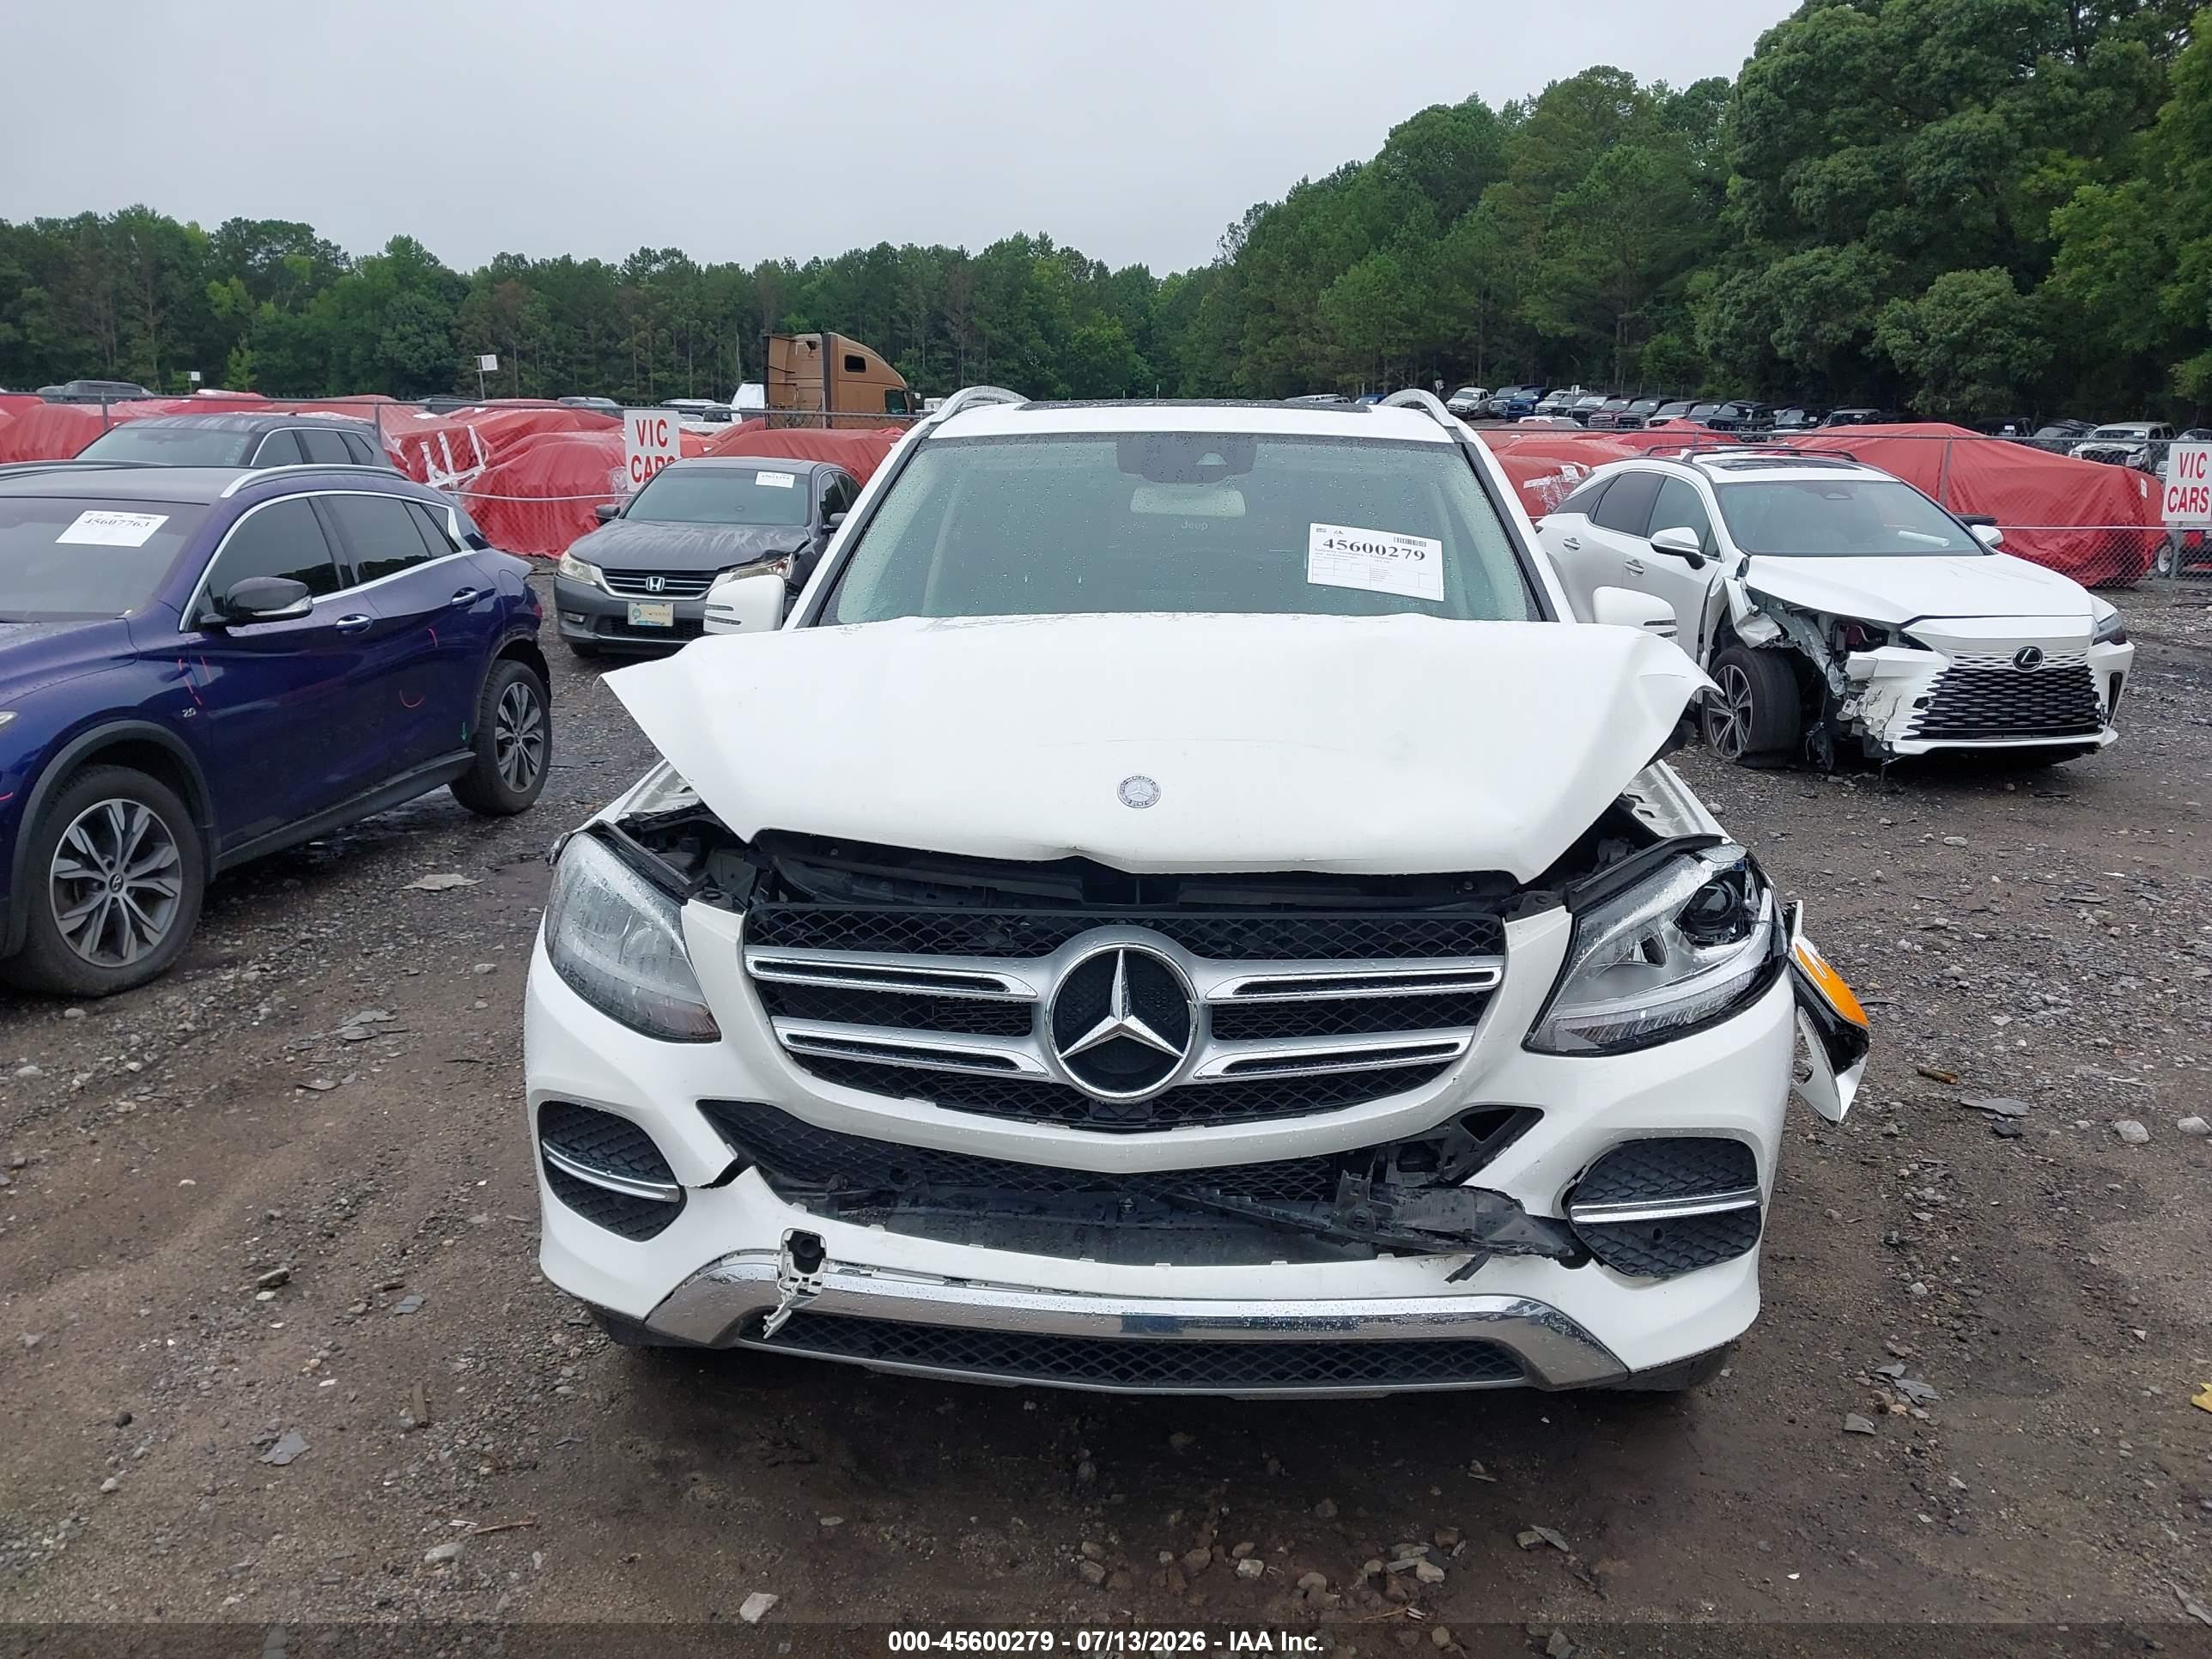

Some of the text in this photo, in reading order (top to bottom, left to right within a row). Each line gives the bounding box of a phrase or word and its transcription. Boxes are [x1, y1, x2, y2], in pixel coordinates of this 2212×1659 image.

[635, 419, 668, 447] VIC
[2179, 452, 2208, 479] VIC
[2167, 486, 2209, 514] CARS
[1181, 520, 1209, 531] Jeep
[1322, 538, 1426, 562] 45600279
